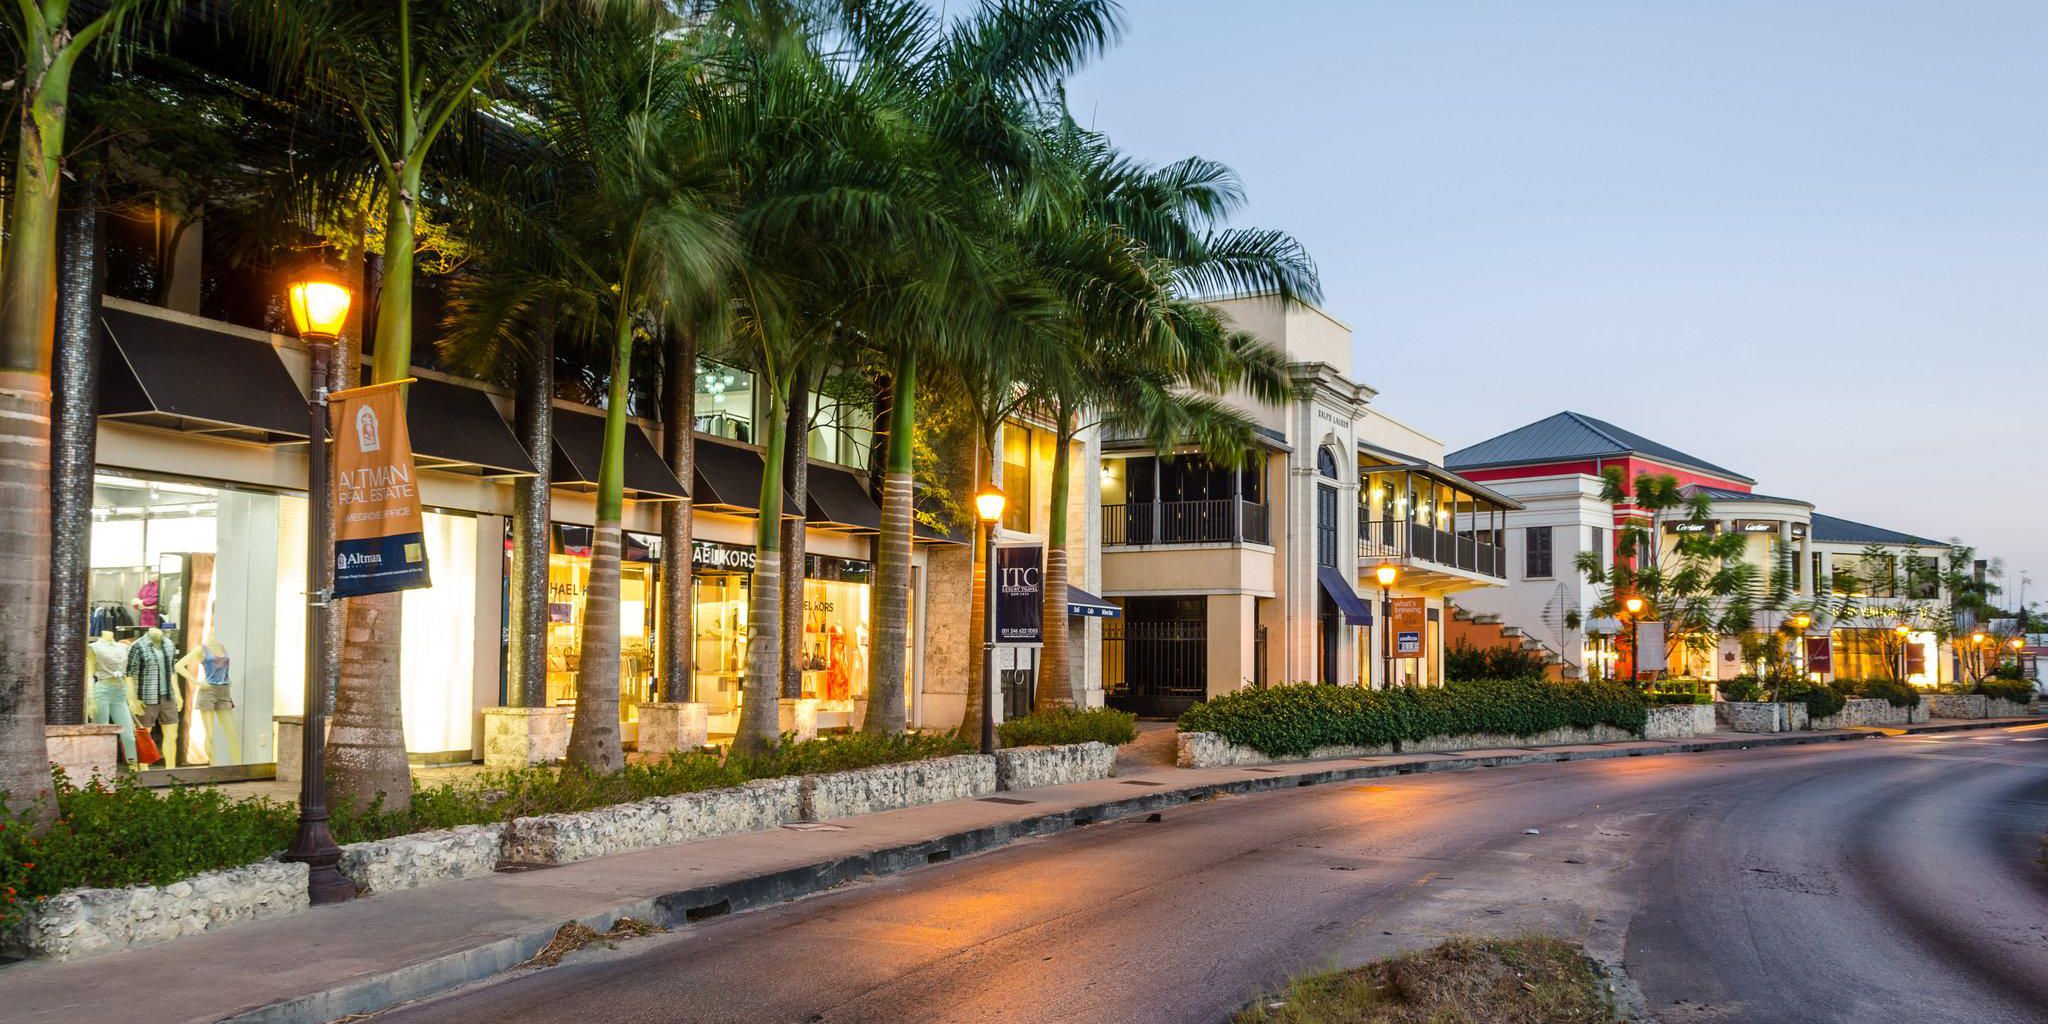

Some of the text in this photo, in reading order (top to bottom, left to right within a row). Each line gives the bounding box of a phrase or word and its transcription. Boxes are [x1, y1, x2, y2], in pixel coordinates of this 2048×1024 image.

[338, 463, 409, 491] ALTMAN
[338, 483, 414, 506] REAL ESTATE
[1745, 523, 1770, 532] Cartier
[347, 553, 382, 565] Altman
[721, 549, 756, 569] KORS
[1002, 567, 1039, 587] ITC
